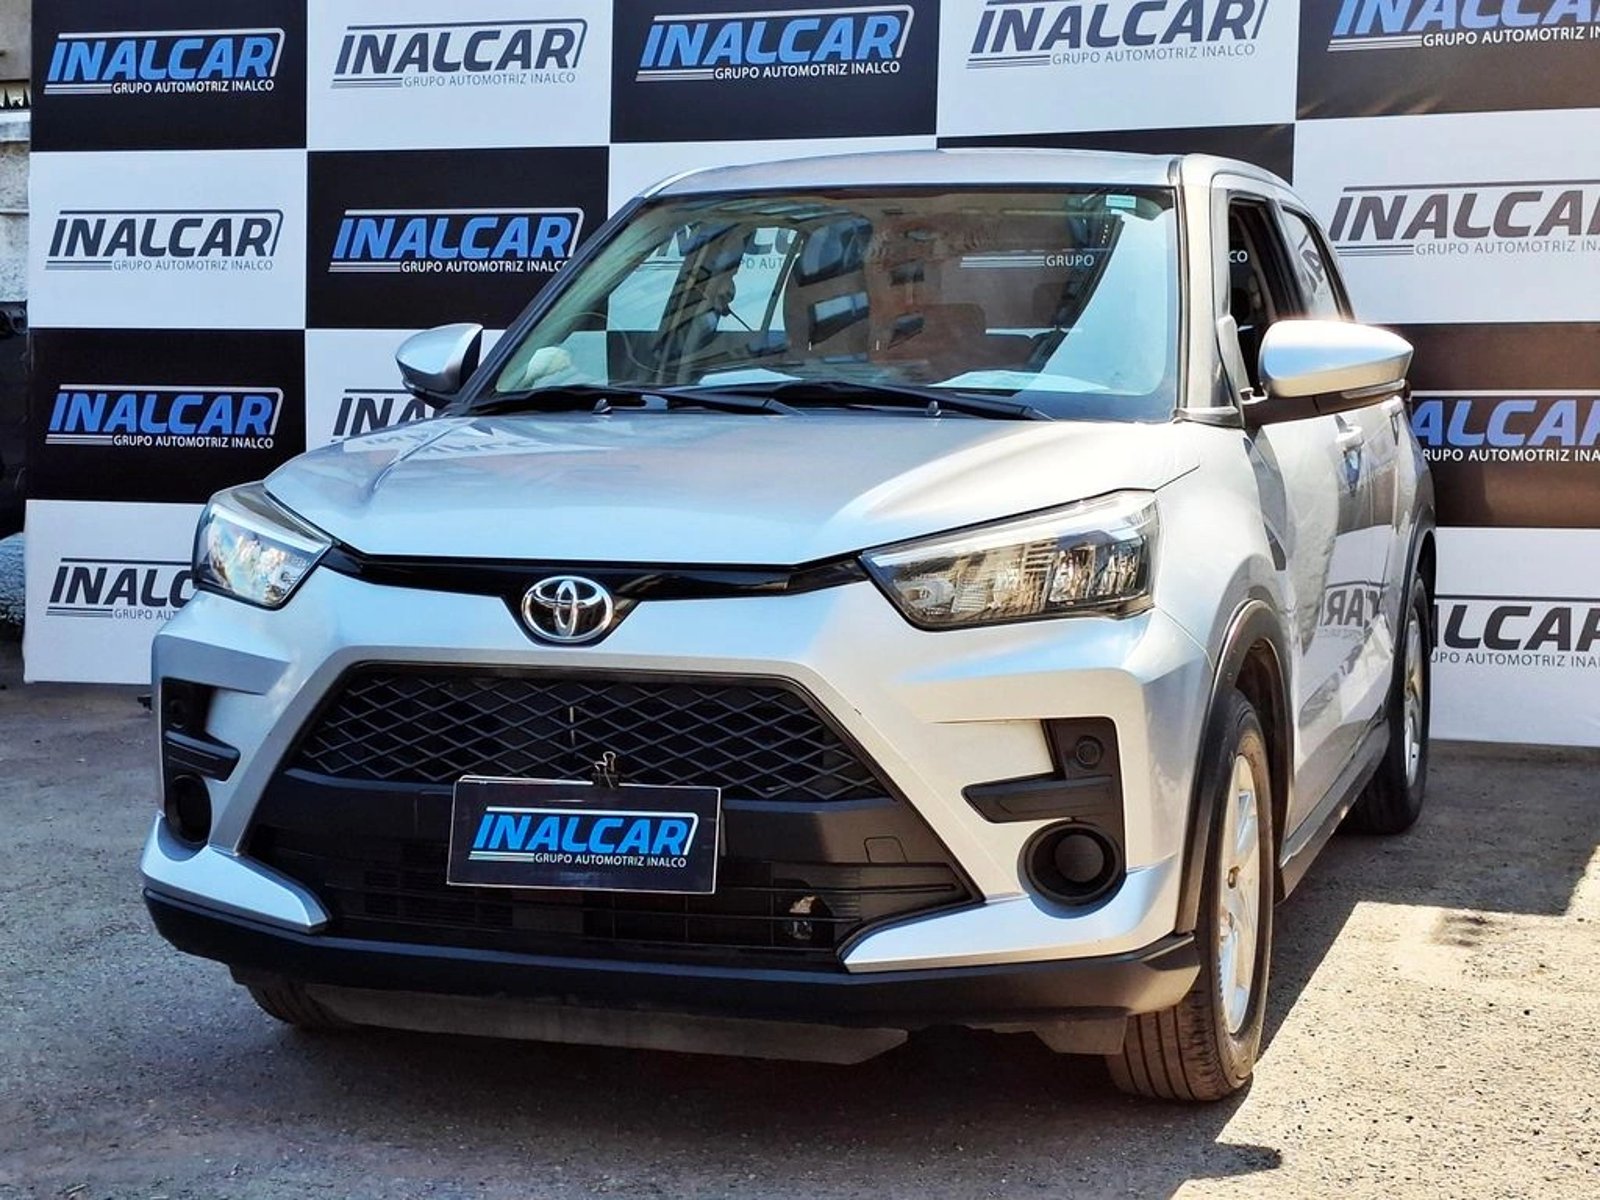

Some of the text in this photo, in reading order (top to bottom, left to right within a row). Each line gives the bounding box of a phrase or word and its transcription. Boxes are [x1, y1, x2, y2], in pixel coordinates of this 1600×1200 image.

[971, 0, 1255, 54] INALCAR
[1332, 0, 1600, 36] INALCA
[642, 14, 898, 67] INALCAR
[1423, 31, 1478, 47] GRUPO
[1481, 26, 1585, 44] AUTOMOTRIZ
[48, 36, 274, 81] INALCAR
[336, 27, 573, 75] INALCAR
[1052, 44, 1256, 66] GRUPO AUTOMOTRIZ INALCO
[404, 73, 576, 88] GRUPO AUTOMOTRIZ INALCO
[714, 61, 900, 80] GRUPO AUTOMOTRIZ INALCO
[112, 79, 274, 94] GRUPO AUTOMOTRIZ INALCO
[1328, 190, 1600, 241] INALCA
[48, 217, 272, 257] INALCAR
[332, 216, 573, 258] INALCAR
[1415, 242, 1469, 256] GRUPO
[1474, 240, 1576, 254] AUTOMOTRIZ
[112, 260, 274, 271] GRUPO AUTOMOTRIZ INALCO
[401, 260, 443, 273] GRUPO
[446, 260, 524, 273] AUTOMOTRIZ
[1046, 255, 1095, 266] GRUPO
[48, 392, 273, 434] INALCAR
[113, 436, 274, 449] GRUPO AUTOMOTRIZ INALCO
[1423, 450, 1463, 461] RUPO
[1468, 450, 1570, 462] AUTOMOTRIZ
[113, 609, 152, 619] GRUPO
[1465, 653, 1565, 667] AUTOMOTRIZ
[473, 815, 688, 855] INALCAR
[535, 852, 687, 868] GRUPO AUTOMOTRIZ INALCO
